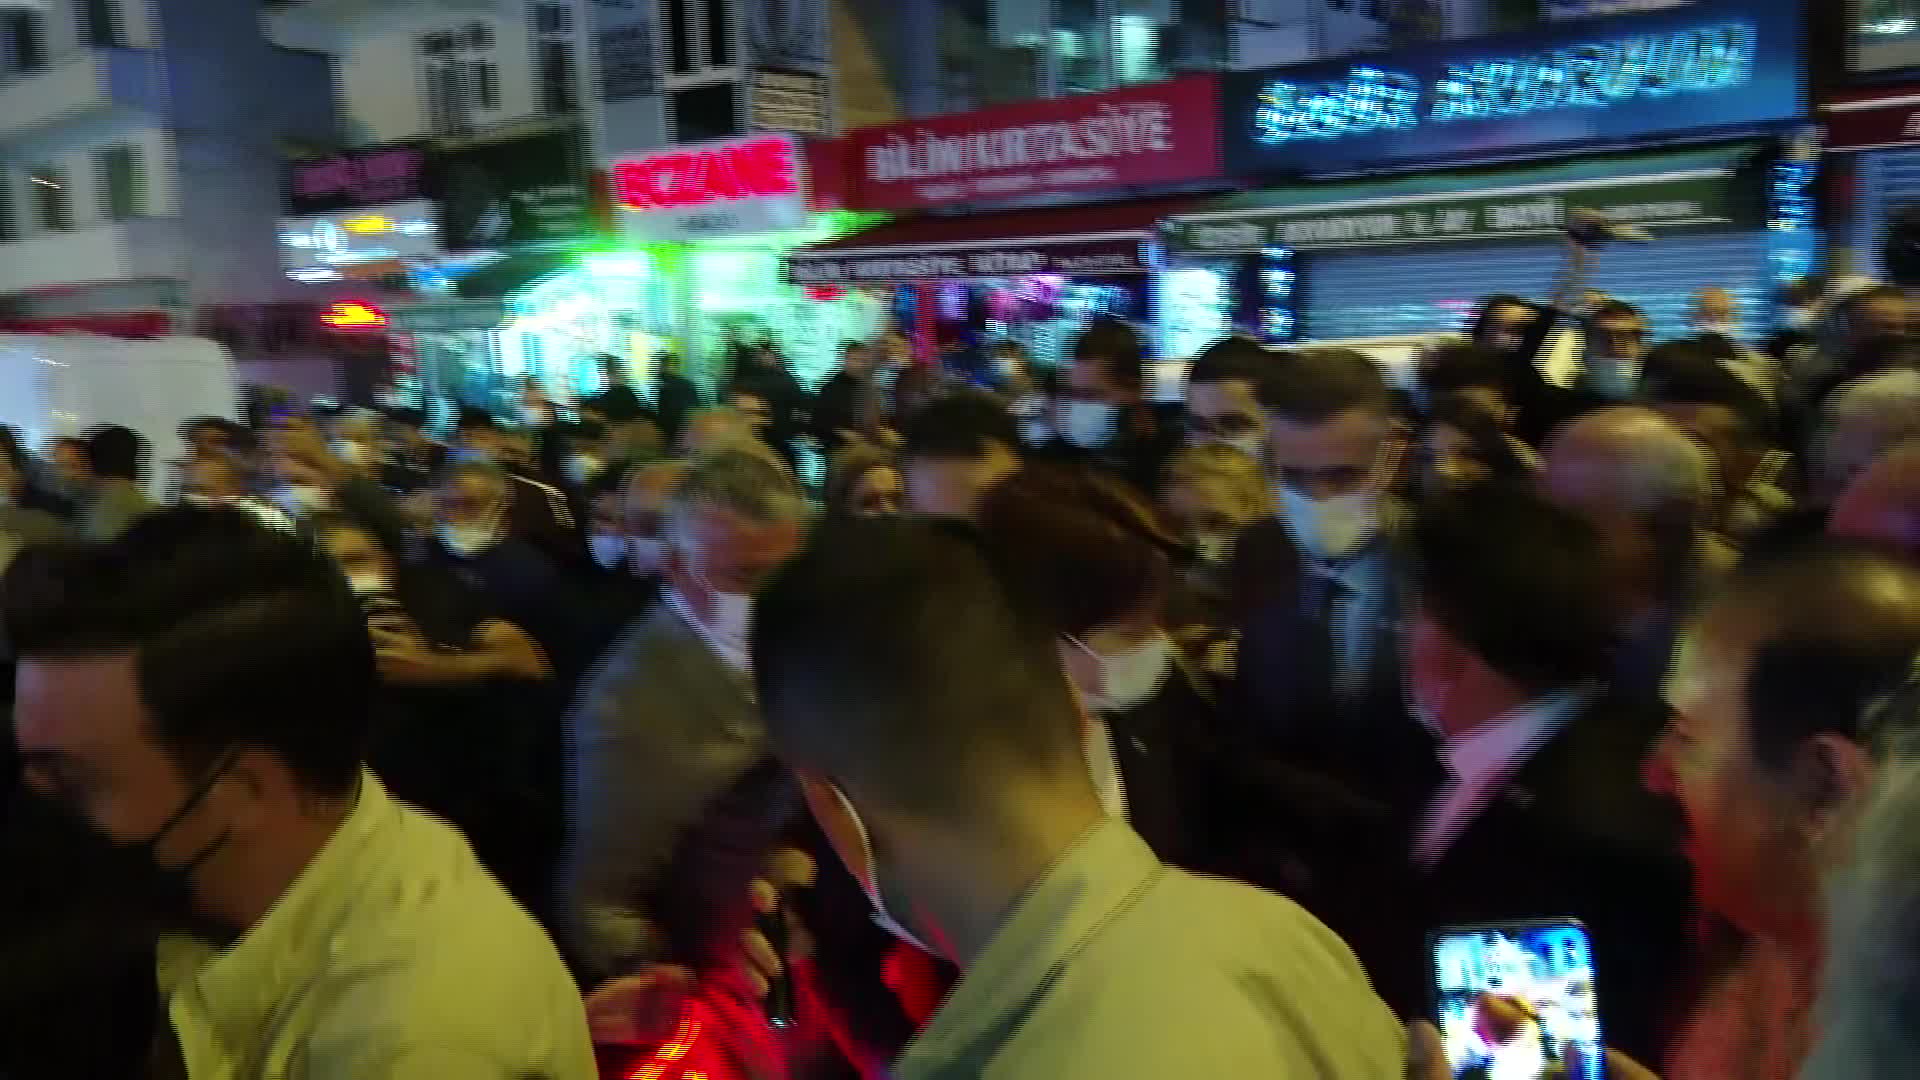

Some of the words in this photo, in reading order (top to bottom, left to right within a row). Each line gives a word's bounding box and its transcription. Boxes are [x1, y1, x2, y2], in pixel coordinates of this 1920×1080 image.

[1429, 23, 1756, 121] AKVARYUM
[614, 138, 797, 207] ECZANE
[866, 130, 971, 182] BİLİM
[967, 100, 1174, 172] KIRTASİYE
